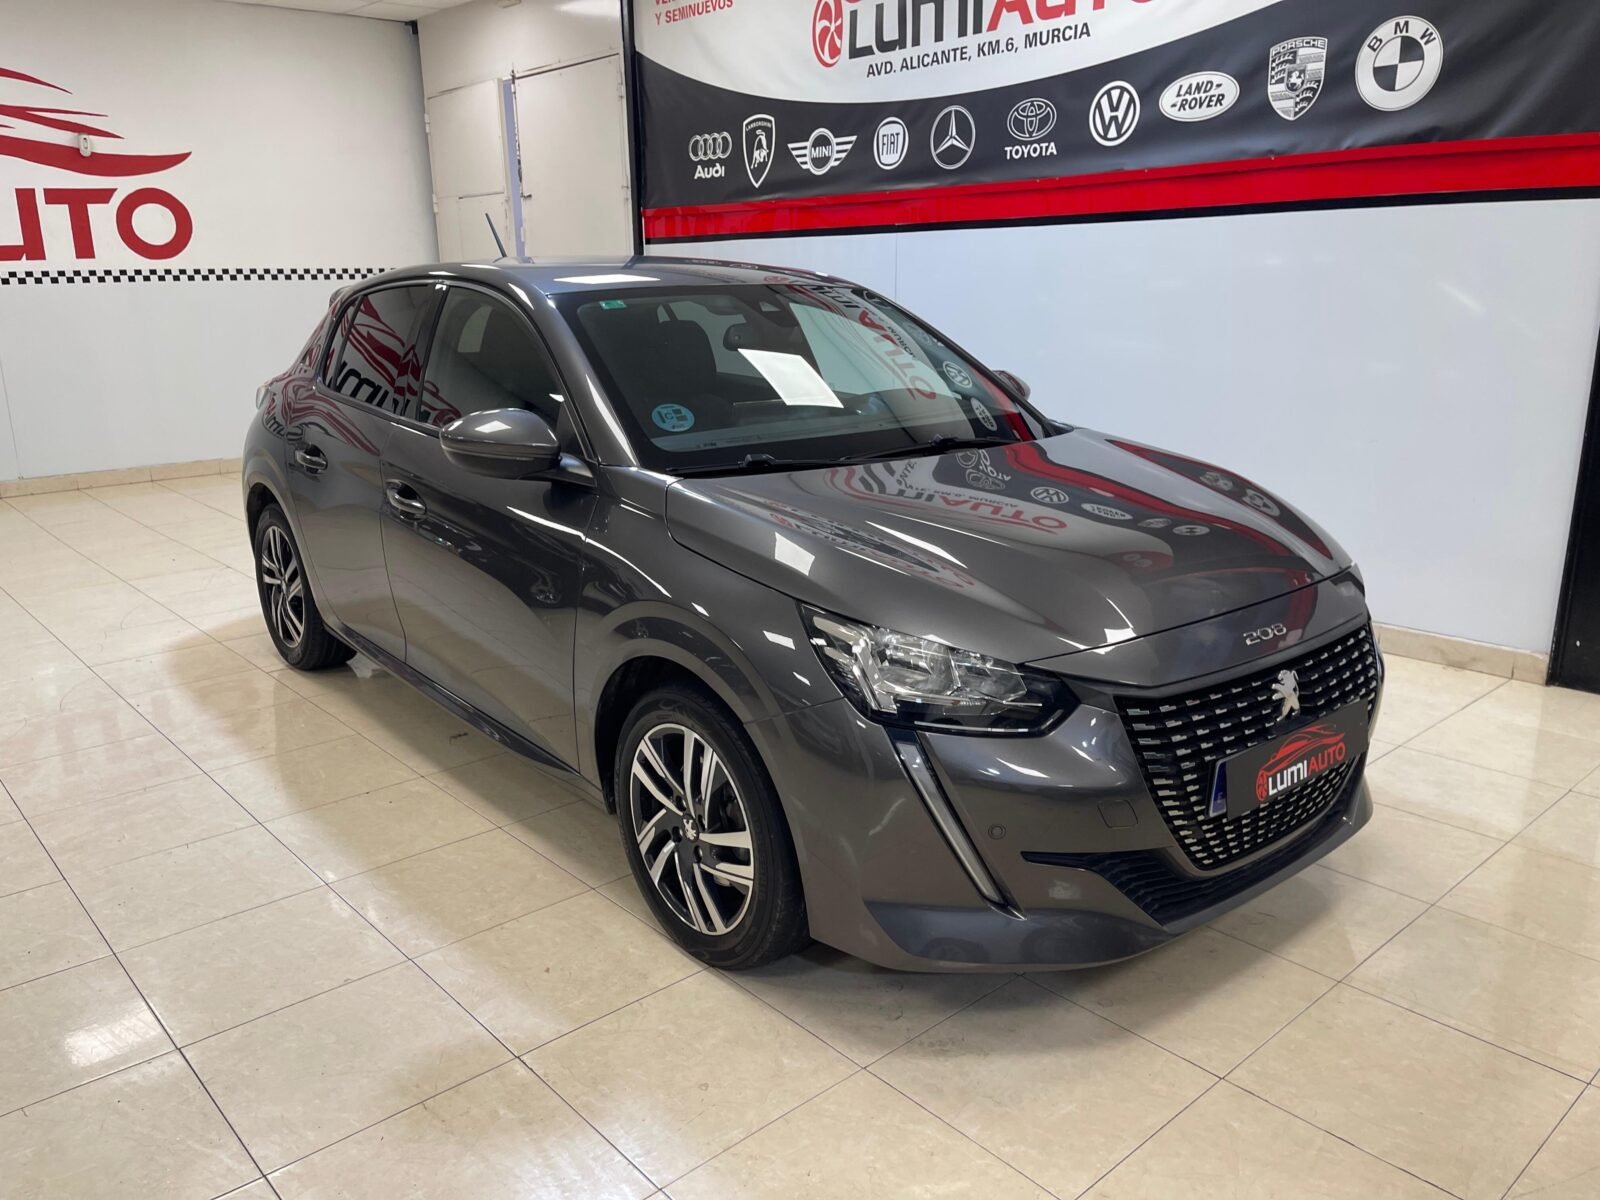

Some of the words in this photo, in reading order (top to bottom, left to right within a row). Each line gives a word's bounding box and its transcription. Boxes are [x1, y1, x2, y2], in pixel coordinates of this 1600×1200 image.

[655, 12, 662, 26] Y
[665, 0, 734, 24] SEMINUEVOS
[1272, 38, 1326, 57] PORSCHE
[1366, 20, 1437, 53] BMW
[866, 60, 897, 78] AVD.
[900, 46, 972, 73] ALICANTE,
[977, 36, 1019, 58] KM.6,
[1024, 22, 1092, 49] MURCIA
[811, 144, 832, 159] MINI
[881, 131, 901, 156] FIAT
[1004, 142, 1057, 160] TOYOTA
[694, 163, 725, 180] Audi
[1242, 623, 1287, 646] 208
